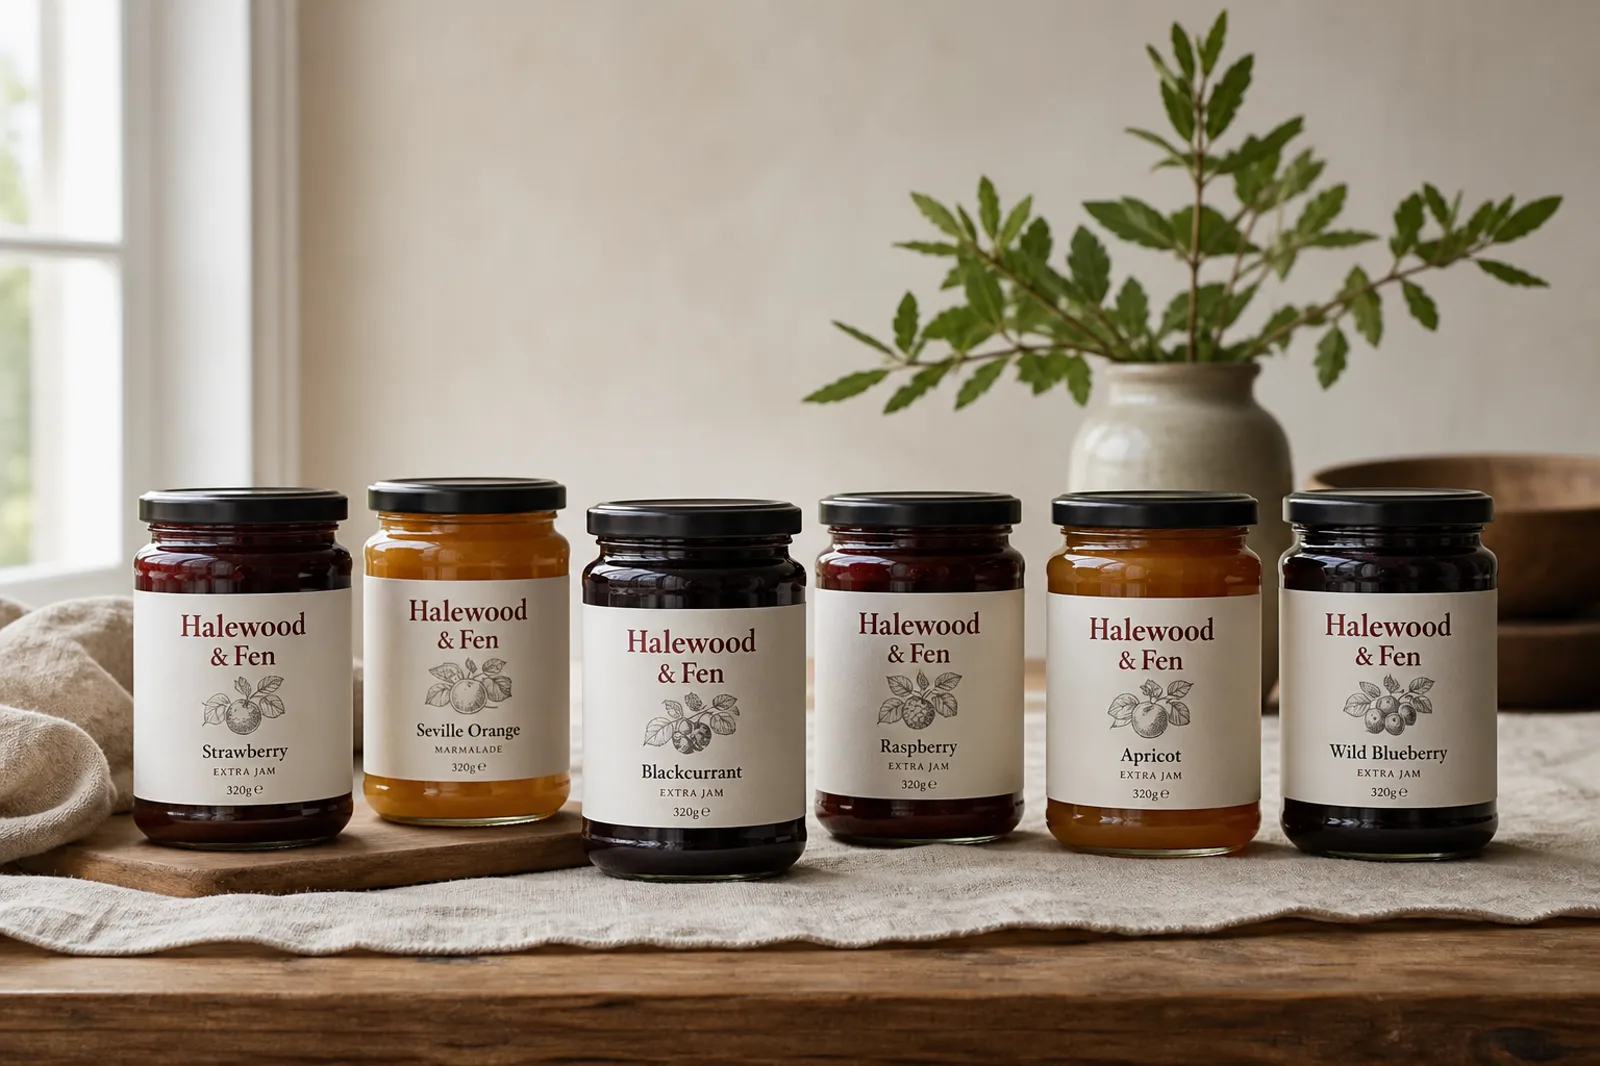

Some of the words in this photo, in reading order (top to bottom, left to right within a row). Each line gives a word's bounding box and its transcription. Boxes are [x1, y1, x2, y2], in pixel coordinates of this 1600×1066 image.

[409, 598, 527, 622] Halewood
[181, 612, 306, 638] Halewood
[859, 611, 980, 635] Halewood
[1089, 617, 1215, 642] Halewood
[1325, 612, 1452, 637] Halewood
[437, 631, 454, 649] &
[459, 629, 499, 649] Fen
[627, 628, 756, 654] Halewood
[211, 647, 229, 666] &
[234, 645, 276, 666] Fen
[888, 645, 905, 663] &
[910, 643, 950, 663] Fen
[1119, 651, 1136, 670] &
[1142, 649, 1183, 670] Fen
[1355, 646, 1373, 666] &
[1379, 645, 1422, 666] Fen
[657, 664, 675, 683] &
[681, 662, 724, 683] Fen
[416, 723, 464, 737] Seville
[468, 723, 520, 740] Orange
[202, 744, 288, 761] Strawberry
[434, 745, 503, 754] MARMALADE
[881, 739, 958, 758] Raspberry
[1120, 748, 1181, 766] Apricot
[1330, 743, 1367, 760] Wild
[1372, 744, 1448, 763] Blueberry
[213, 768, 250, 776] EXTRA
[254, 767, 276, 777] JAM
[642, 764, 742, 779] Blackcurrant
[888, 762, 924, 770] EXTRA
[928, 762, 949, 772] JAM
[1120, 771, 1156, 779] EXTRA
[1160, 771, 1182, 781] JAM
[1357, 769, 1395, 777] EXTRA
[1399, 769, 1421, 779] JAM
[660, 789, 697, 797] EXTRA
[700, 788, 724, 799] JAM
